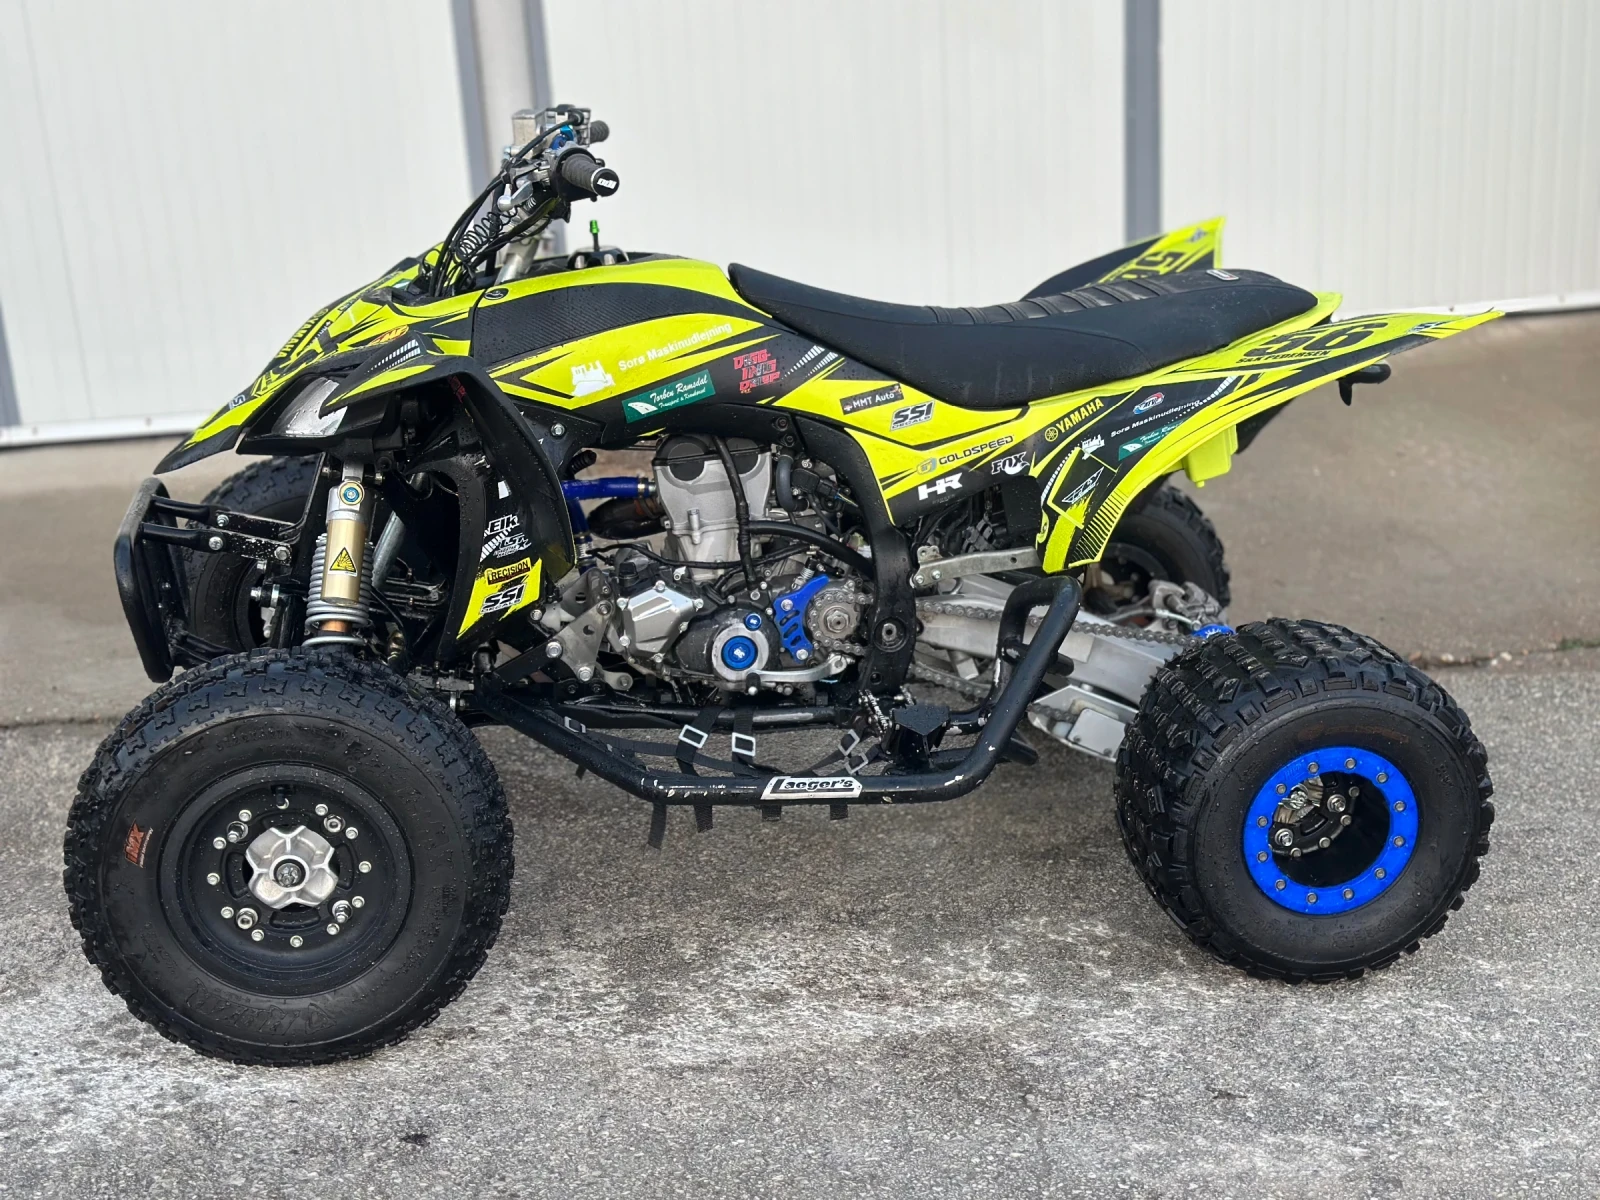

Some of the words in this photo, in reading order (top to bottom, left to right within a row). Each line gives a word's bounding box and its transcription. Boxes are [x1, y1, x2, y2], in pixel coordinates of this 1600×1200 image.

[646, 322, 733, 362] Maskinudlejning
[1244, 322, 1389, 356] 56
[650, 388, 674, 404] Torben
[676, 374, 708, 394] Ramsdal
[852, 397, 872, 409] MMT
[875, 392, 895, 402] Auto
[892, 416, 931, 429] DECALS
[894, 402, 934, 424] SSI
[1056, 397, 1104, 432] YAMAHA
[938, 436, 1014, 465] GOLDSPEED
[992, 451, 1030, 474] FOX
[484, 584, 525, 608] SSI
